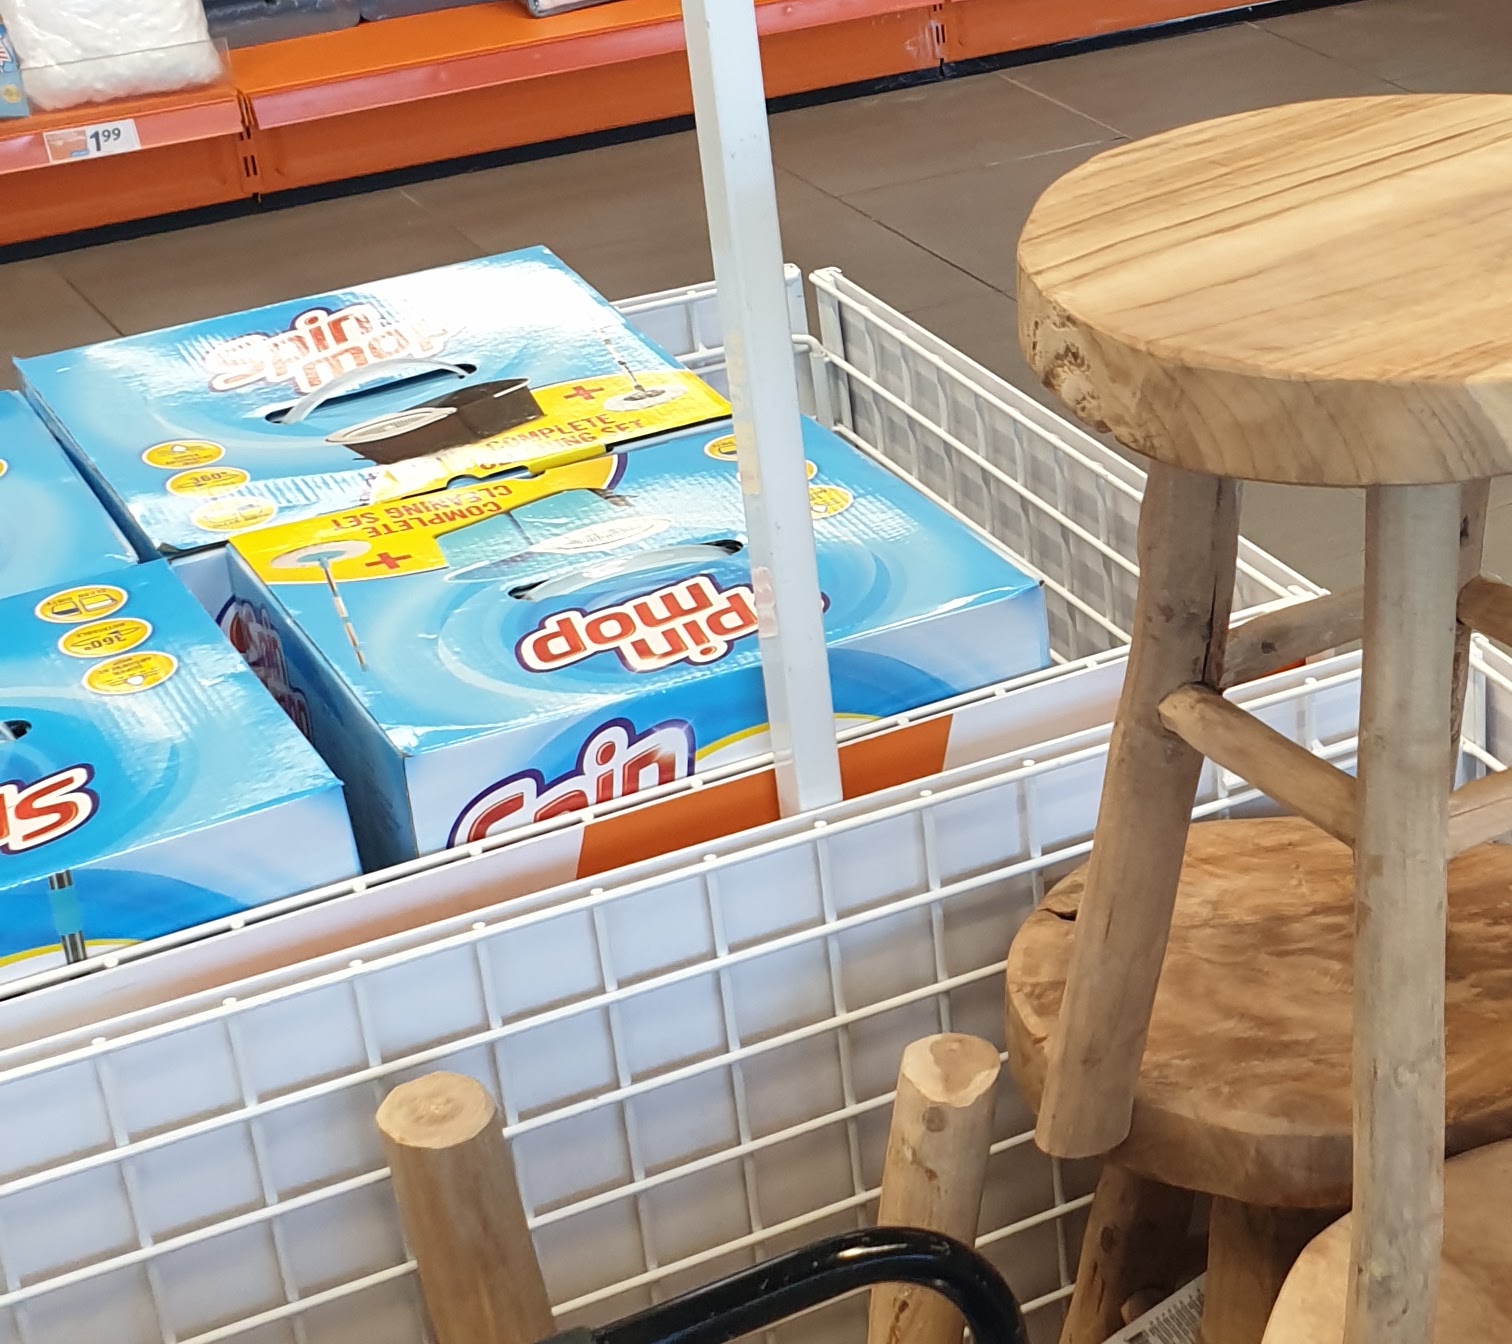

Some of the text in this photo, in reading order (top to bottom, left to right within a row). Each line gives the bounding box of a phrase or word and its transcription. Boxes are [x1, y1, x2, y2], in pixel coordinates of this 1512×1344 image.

[485, 413, 617, 452] COMPLETE
[331, 484, 514, 532] CLEANING SET
[368, 500, 503, 538] COMPLETE
[529, 581, 715, 666] mop
[632, 593, 760, 673] pin
